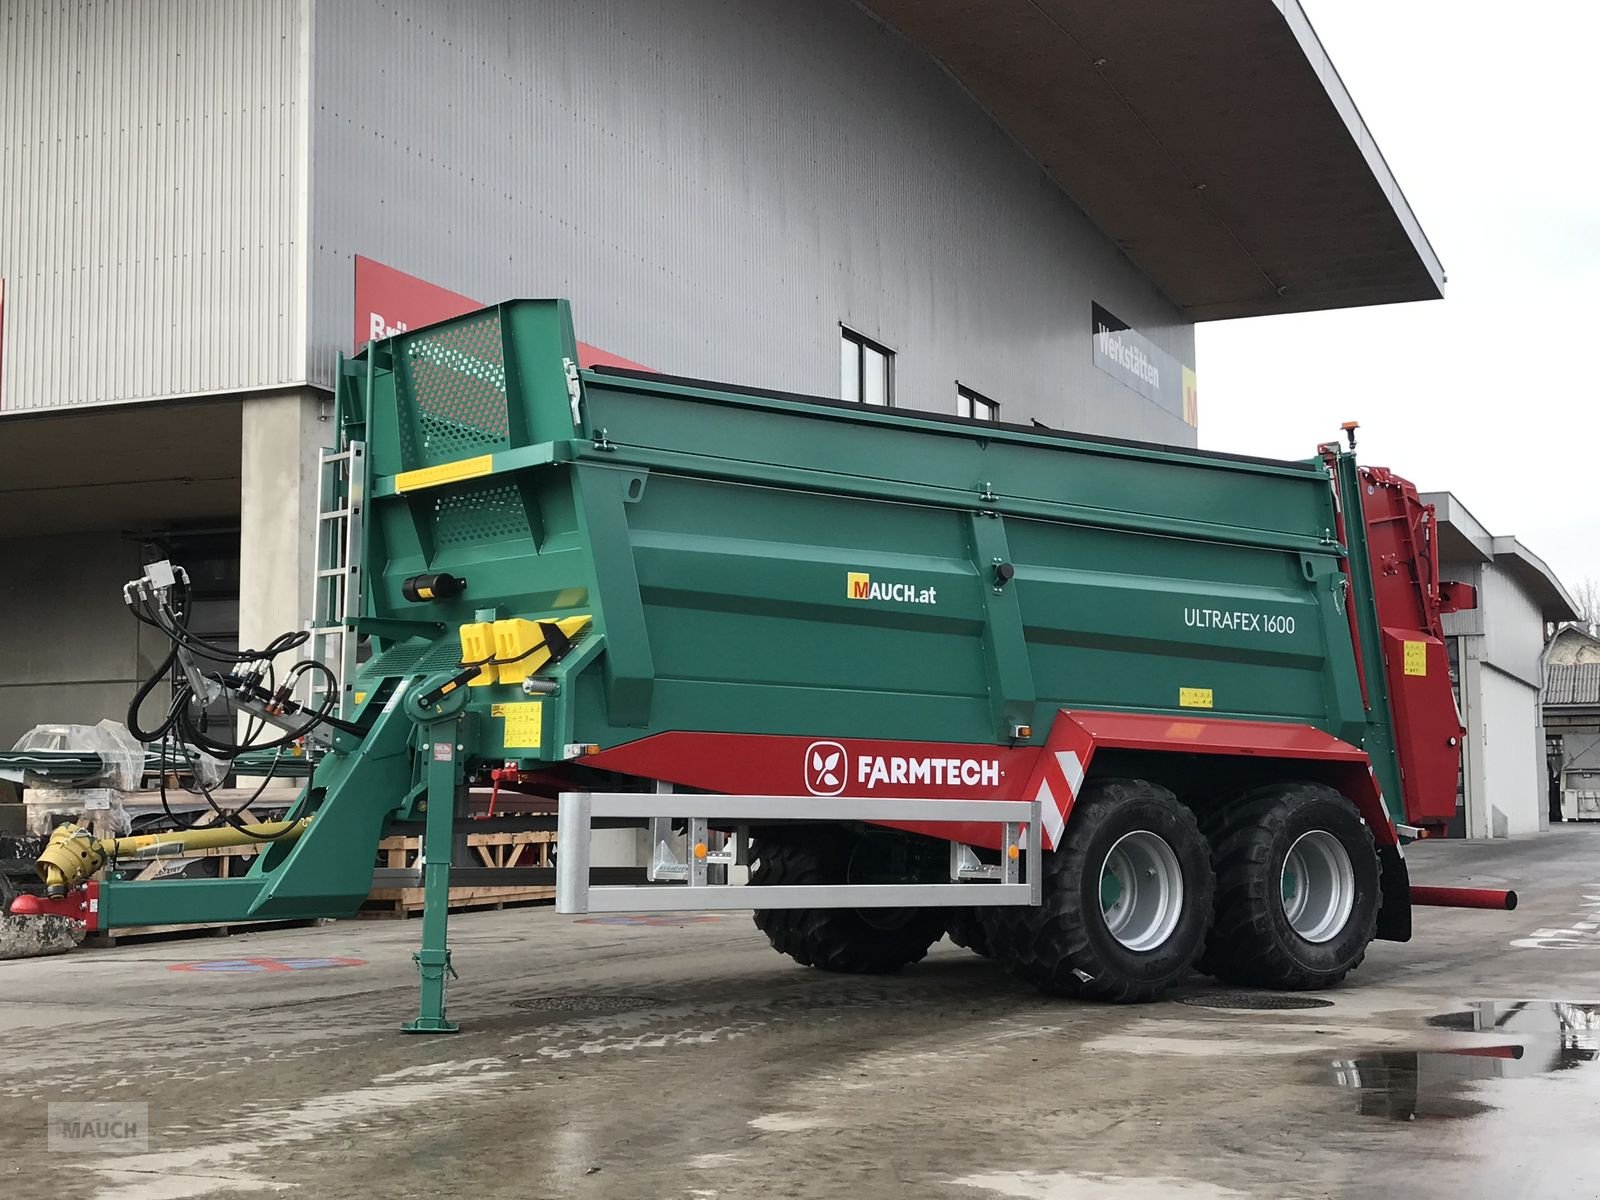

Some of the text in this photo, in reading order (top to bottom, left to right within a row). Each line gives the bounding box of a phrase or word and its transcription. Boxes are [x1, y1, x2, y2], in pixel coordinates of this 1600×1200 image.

[1098, 322, 1160, 389] Werkstätten
[854, 581, 936, 604] MAUCH.at
[1184, 607, 1295, 634] ULTRAFEX 1600
[858, 755, 999, 789] FARMTECH
